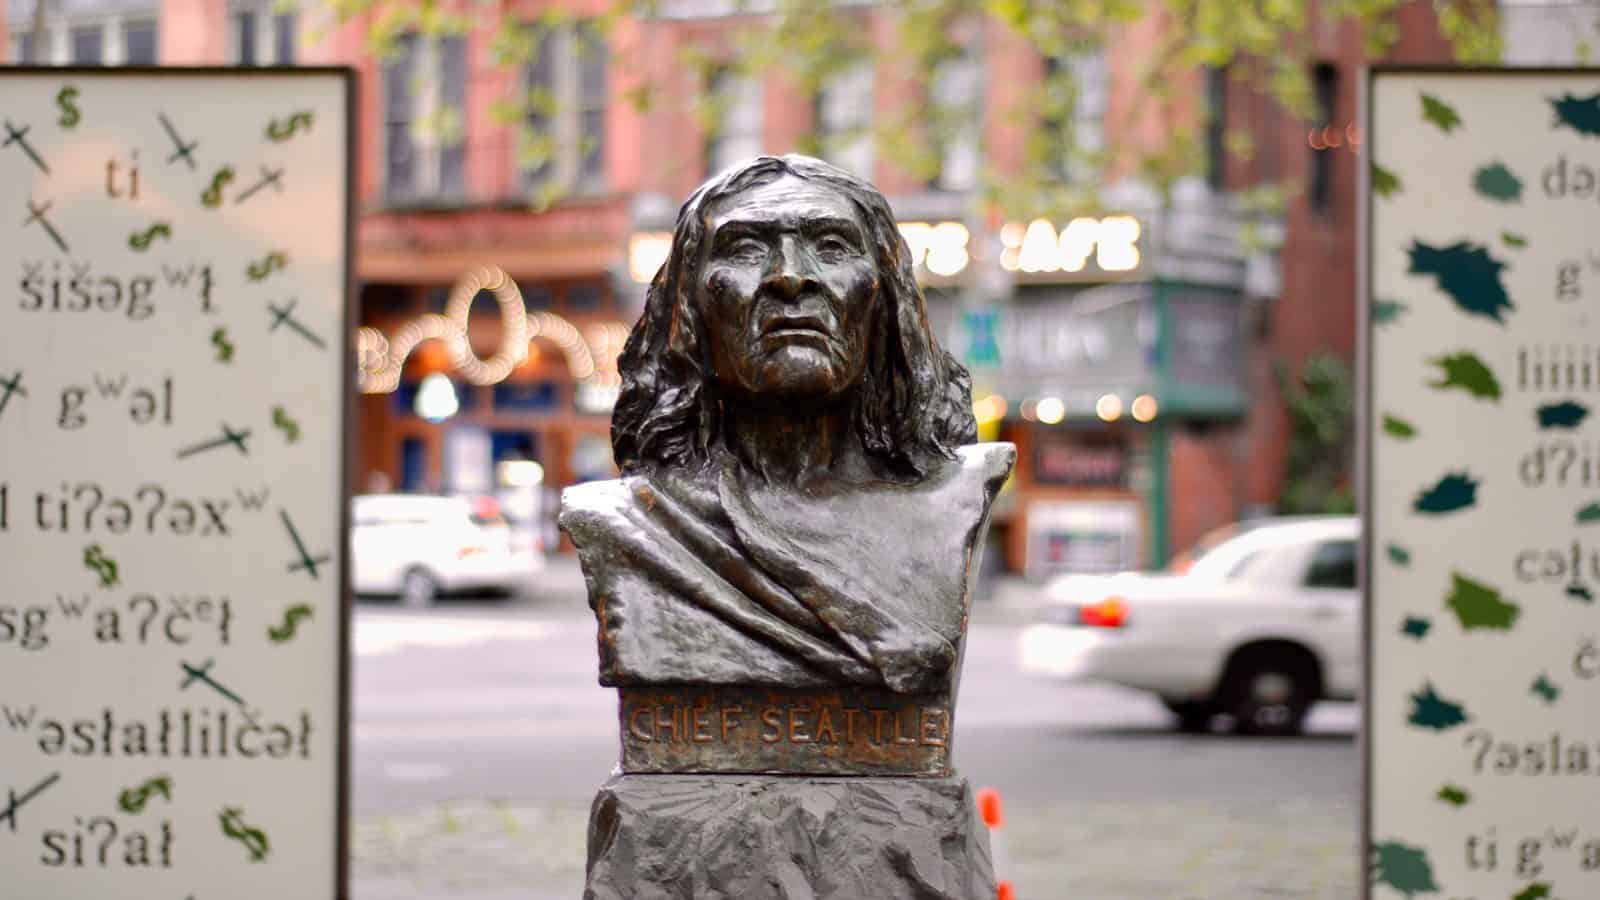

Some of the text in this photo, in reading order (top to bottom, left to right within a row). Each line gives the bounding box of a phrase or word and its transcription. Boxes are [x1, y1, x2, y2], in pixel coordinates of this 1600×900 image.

[106, 147, 140, 200] ti
[1542, 156, 1600, 202] də
[629, 706, 949, 746] CHIEF SEATTLE
[1466, 826, 1498, 871] ti
